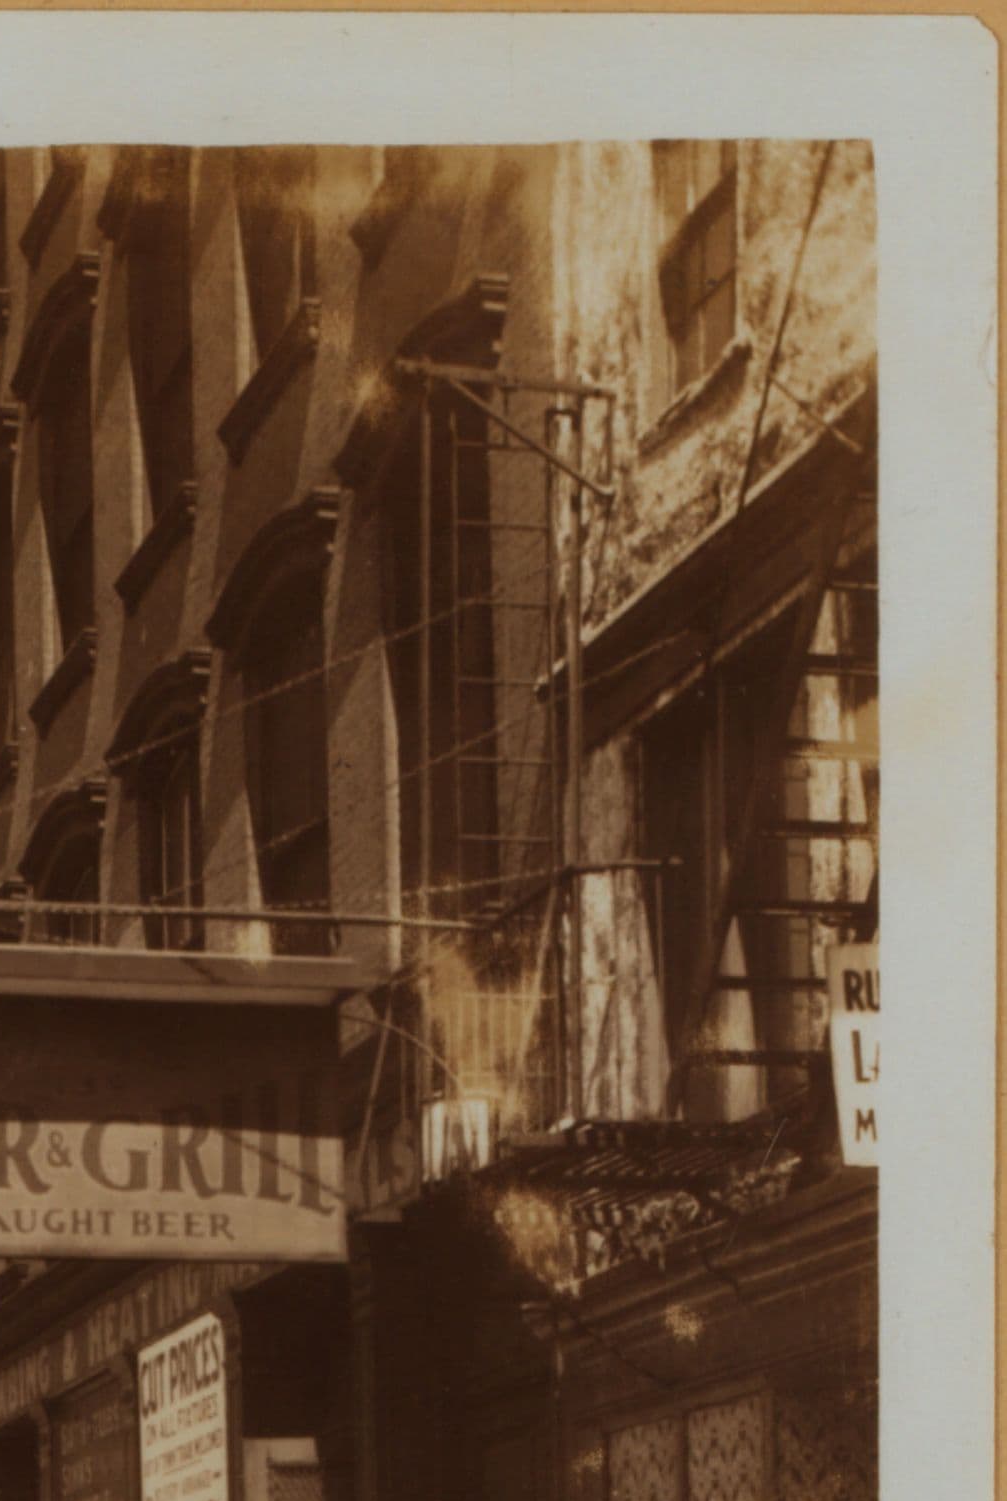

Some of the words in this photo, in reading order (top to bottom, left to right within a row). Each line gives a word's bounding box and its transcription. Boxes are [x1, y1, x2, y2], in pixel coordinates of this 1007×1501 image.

[46, 1129, 74, 1169] &
[80, 1073, 336, 1216] GRILL
[131, 1213, 236, 1241] BEER
[86, 1264, 202, 1367] HEATING
[141, 1350, 167, 1420] CUT
[168, 1324, 222, 1405] PRICES
